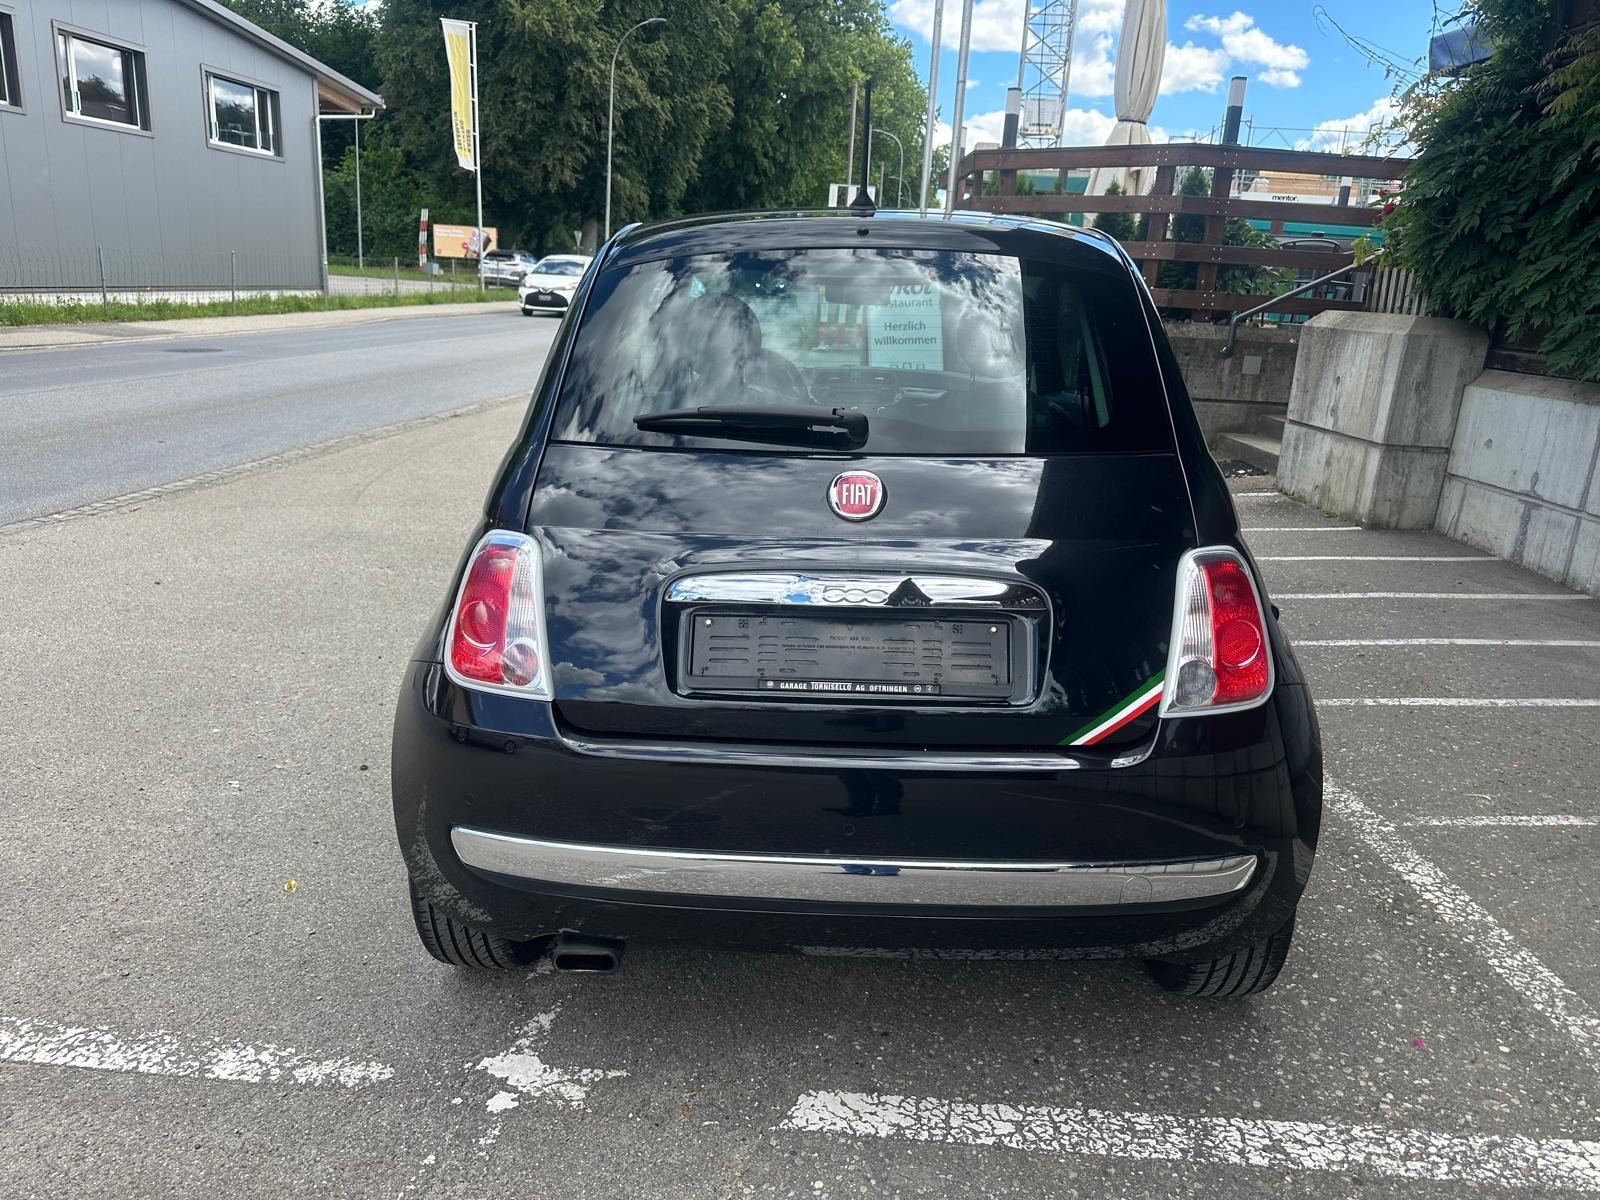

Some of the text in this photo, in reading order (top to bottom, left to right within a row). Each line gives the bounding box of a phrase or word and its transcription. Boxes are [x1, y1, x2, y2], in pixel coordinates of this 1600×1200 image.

[884, 322, 927, 331] Herzlich
[874, 335, 937, 345] willkommen
[842, 483, 874, 505] FIAT
[822, 585, 889, 604] 500
[780, 682, 808, 690] GARAGE
[811, 681, 852, 691] TORNISELLO
[869, 684, 908, 693] OFTRINGEN
